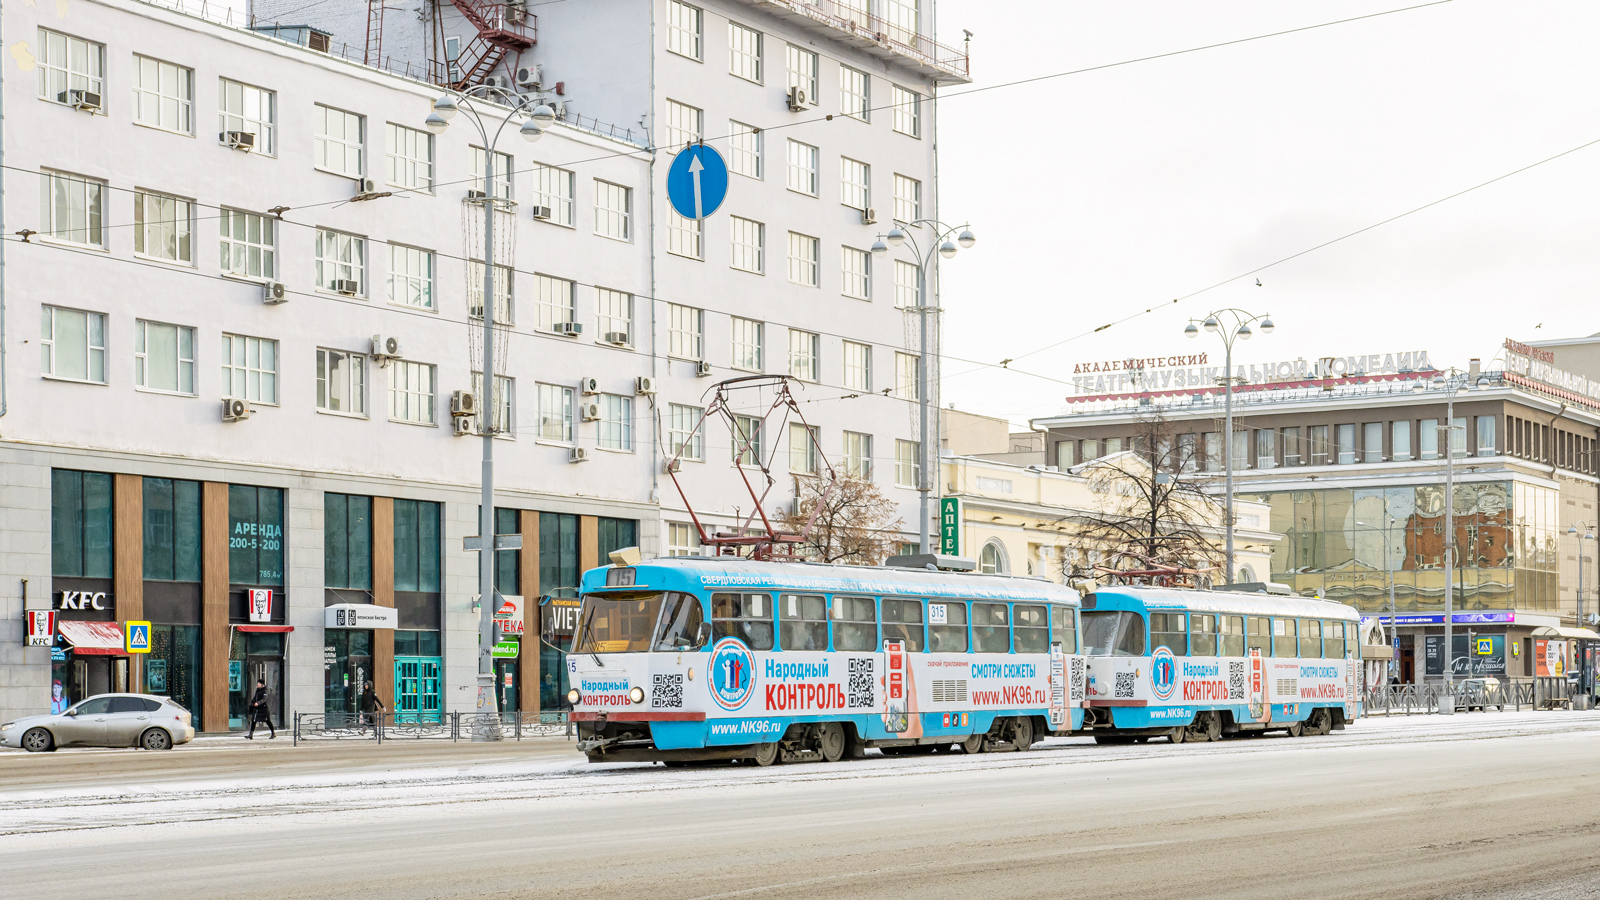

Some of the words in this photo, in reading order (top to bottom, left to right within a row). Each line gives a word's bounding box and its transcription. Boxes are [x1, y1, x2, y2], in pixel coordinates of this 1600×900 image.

[1073, 352, 1208, 374] АКАДЕМИЧЕСКИЙ
[1072, 374, 1130, 394] ТЕАТР
[1318, 350, 1428, 376] КОМЕДИИ
[234, 522, 282, 539] АРЕНДА
[230, 537, 280, 550] 200-5-200
[615, 570, 630, 586] 15
[700, 575, 762, 586] СВЕРДЛОВСКАЯ
[60, 590, 106, 610] KFC
[931, 606, 944, 618] 315
[494, 620, 524, 632] ТЕКА
[568, 662, 576, 672] 15
[765, 658, 829, 682] Народный
[972, 664, 1002, 678] СМОТРИ
[1004, 664, 1036, 678] СЮЖЕТЫ
[1183, 662, 1219, 678] Народный
[1300, 666, 1318, 678] СМОТРИ
[1318, 666, 1338, 679] СЮЖЕТЫ
[582, 679, 629, 693] Народный
[1183, 680, 1229, 700] КОНТРОЛЬ
[1300, 684, 1344, 698] www.NK96.ru
[583, 694, 631, 706] КОНТРОЛЬ
[765, 683, 846, 710] КОНТРОЛЬ
[972, 686, 1046, 705] www.NK96.ru
[1150, 708, 1192, 719] www.NK96.ru
[712, 720, 781, 735] www.NK96.ru
